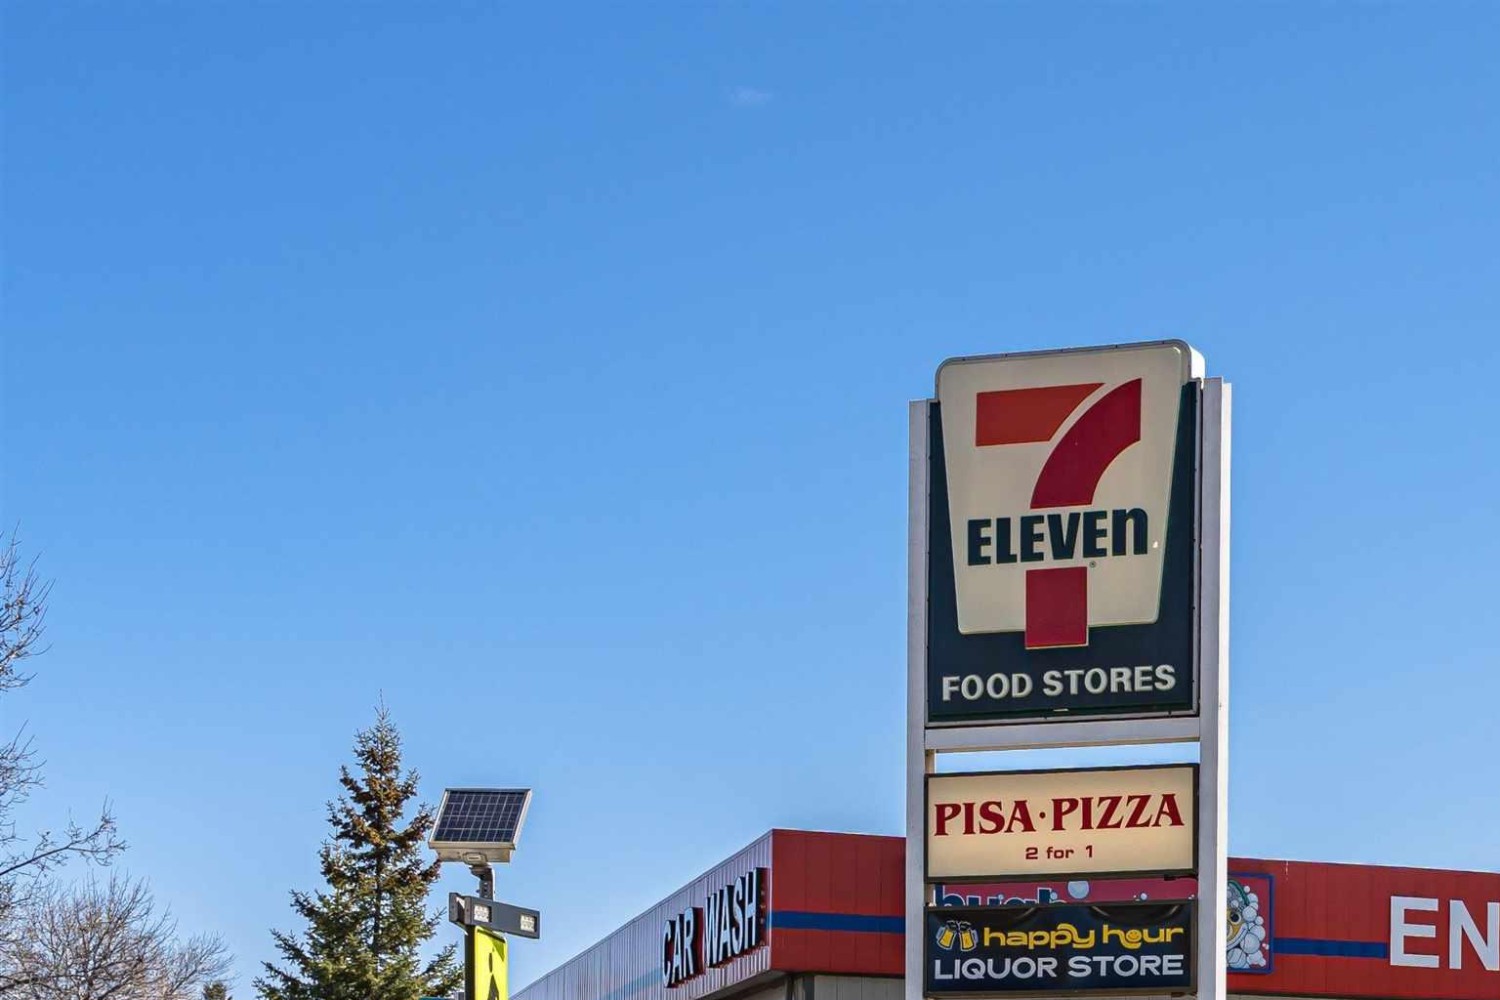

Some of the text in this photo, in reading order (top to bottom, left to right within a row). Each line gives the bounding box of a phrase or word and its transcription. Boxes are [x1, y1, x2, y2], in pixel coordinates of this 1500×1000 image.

[942, 664, 1176, 701] FOOD STORES
[1025, 845, 1094, 860] 2 for 1
[662, 867, 760, 988] CAR WASH
[983, 923, 1095, 949] happy
[934, 954, 1184, 980] LIQUOR STORE
